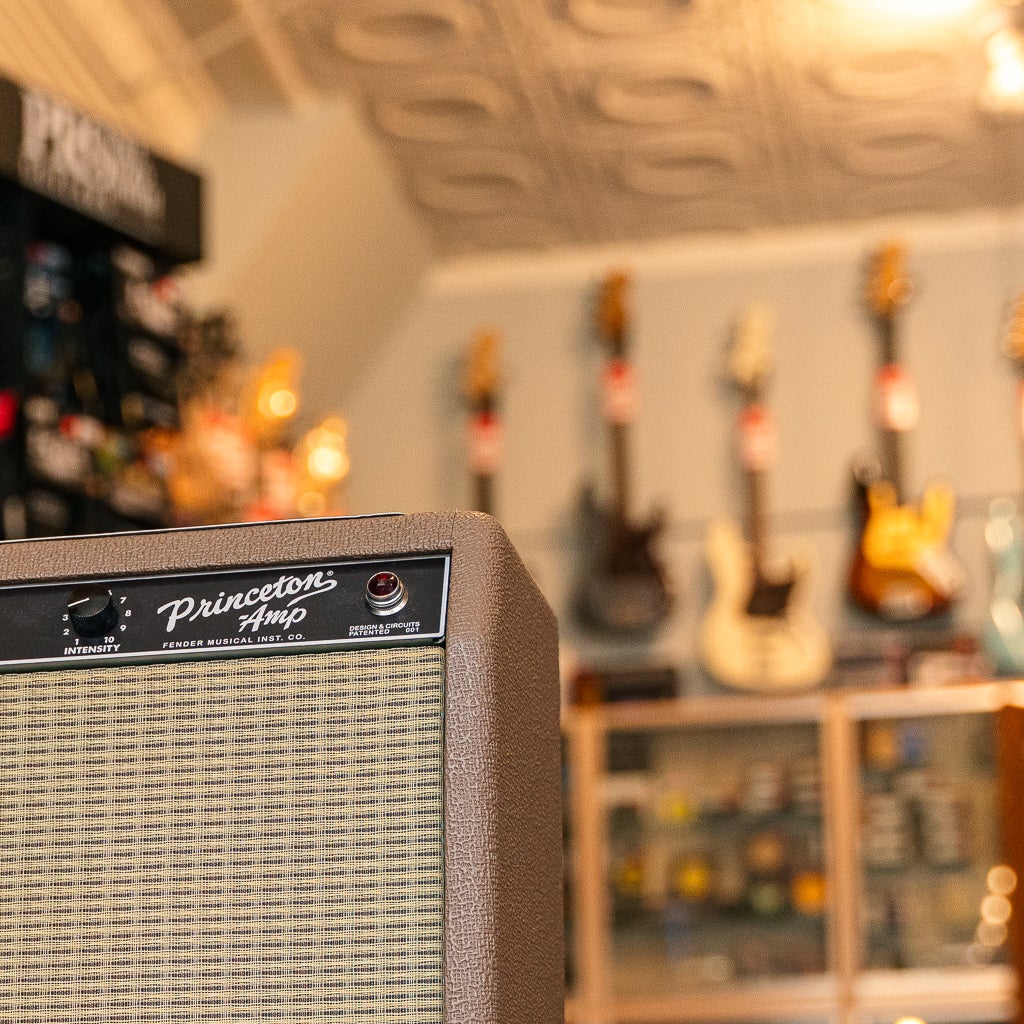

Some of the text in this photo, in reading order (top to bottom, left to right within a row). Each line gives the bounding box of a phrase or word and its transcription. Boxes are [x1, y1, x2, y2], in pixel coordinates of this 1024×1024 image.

[120, 596, 127, 604] 7
[124, 609, 132, 617] 8
[238, 603, 307, 633] Amp
[120, 624, 127, 632] 9
[349, 623, 378, 632] DESIGN
[385, 621, 421, 629] CIRCUITS
[62, 628, 70, 636] 2
[348, 628, 390, 637] PATENTED
[162, 633, 306, 649] FENDER MUSICAL INST. CO.
[63, 644, 121, 655] INTENSITY
